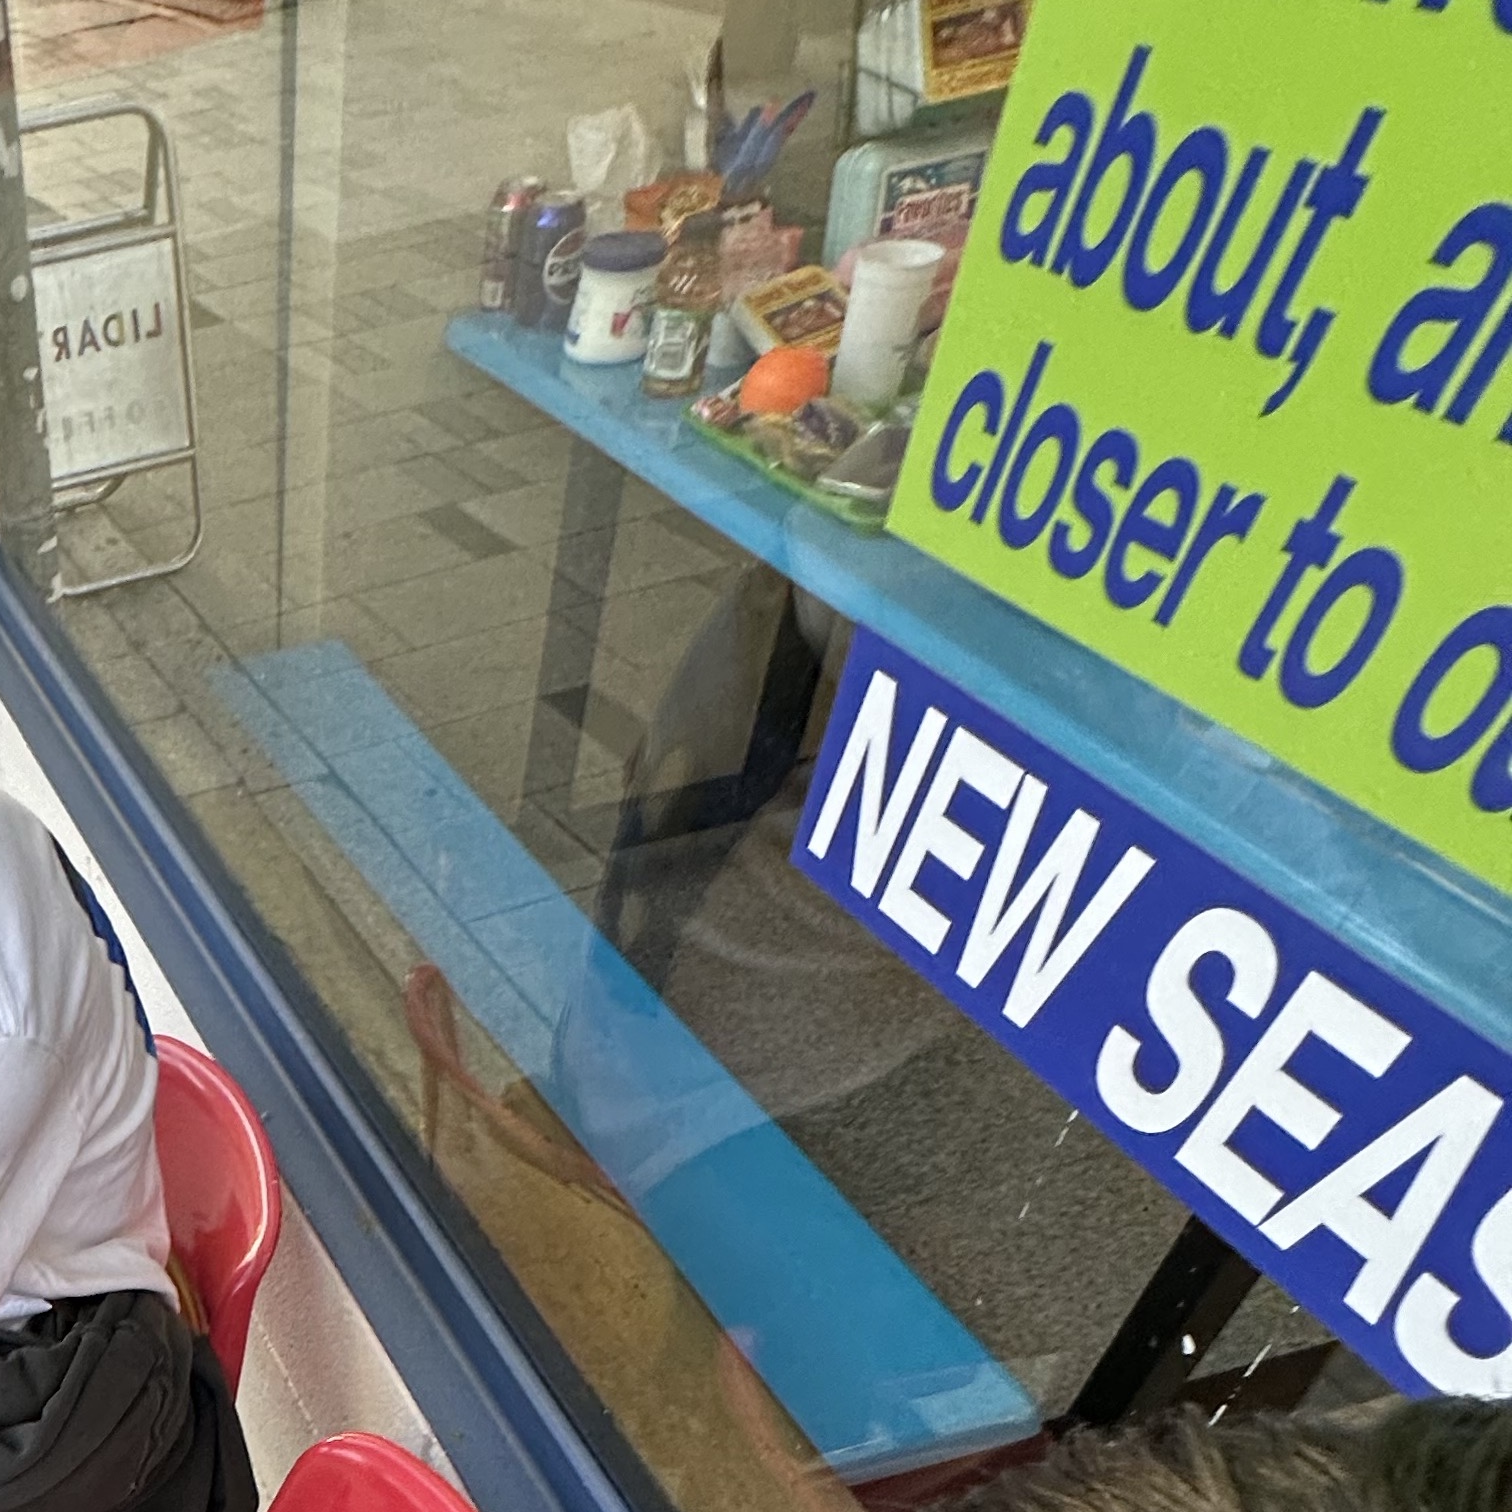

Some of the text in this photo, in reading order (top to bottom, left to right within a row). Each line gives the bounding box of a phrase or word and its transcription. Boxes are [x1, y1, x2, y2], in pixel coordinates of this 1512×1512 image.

[1000, 45, 1385, 416] about,
[930, 341, 1266, 627] closer
[1237, 474, 1405, 710] to
[806, 669, 1157, 1030] NEW
